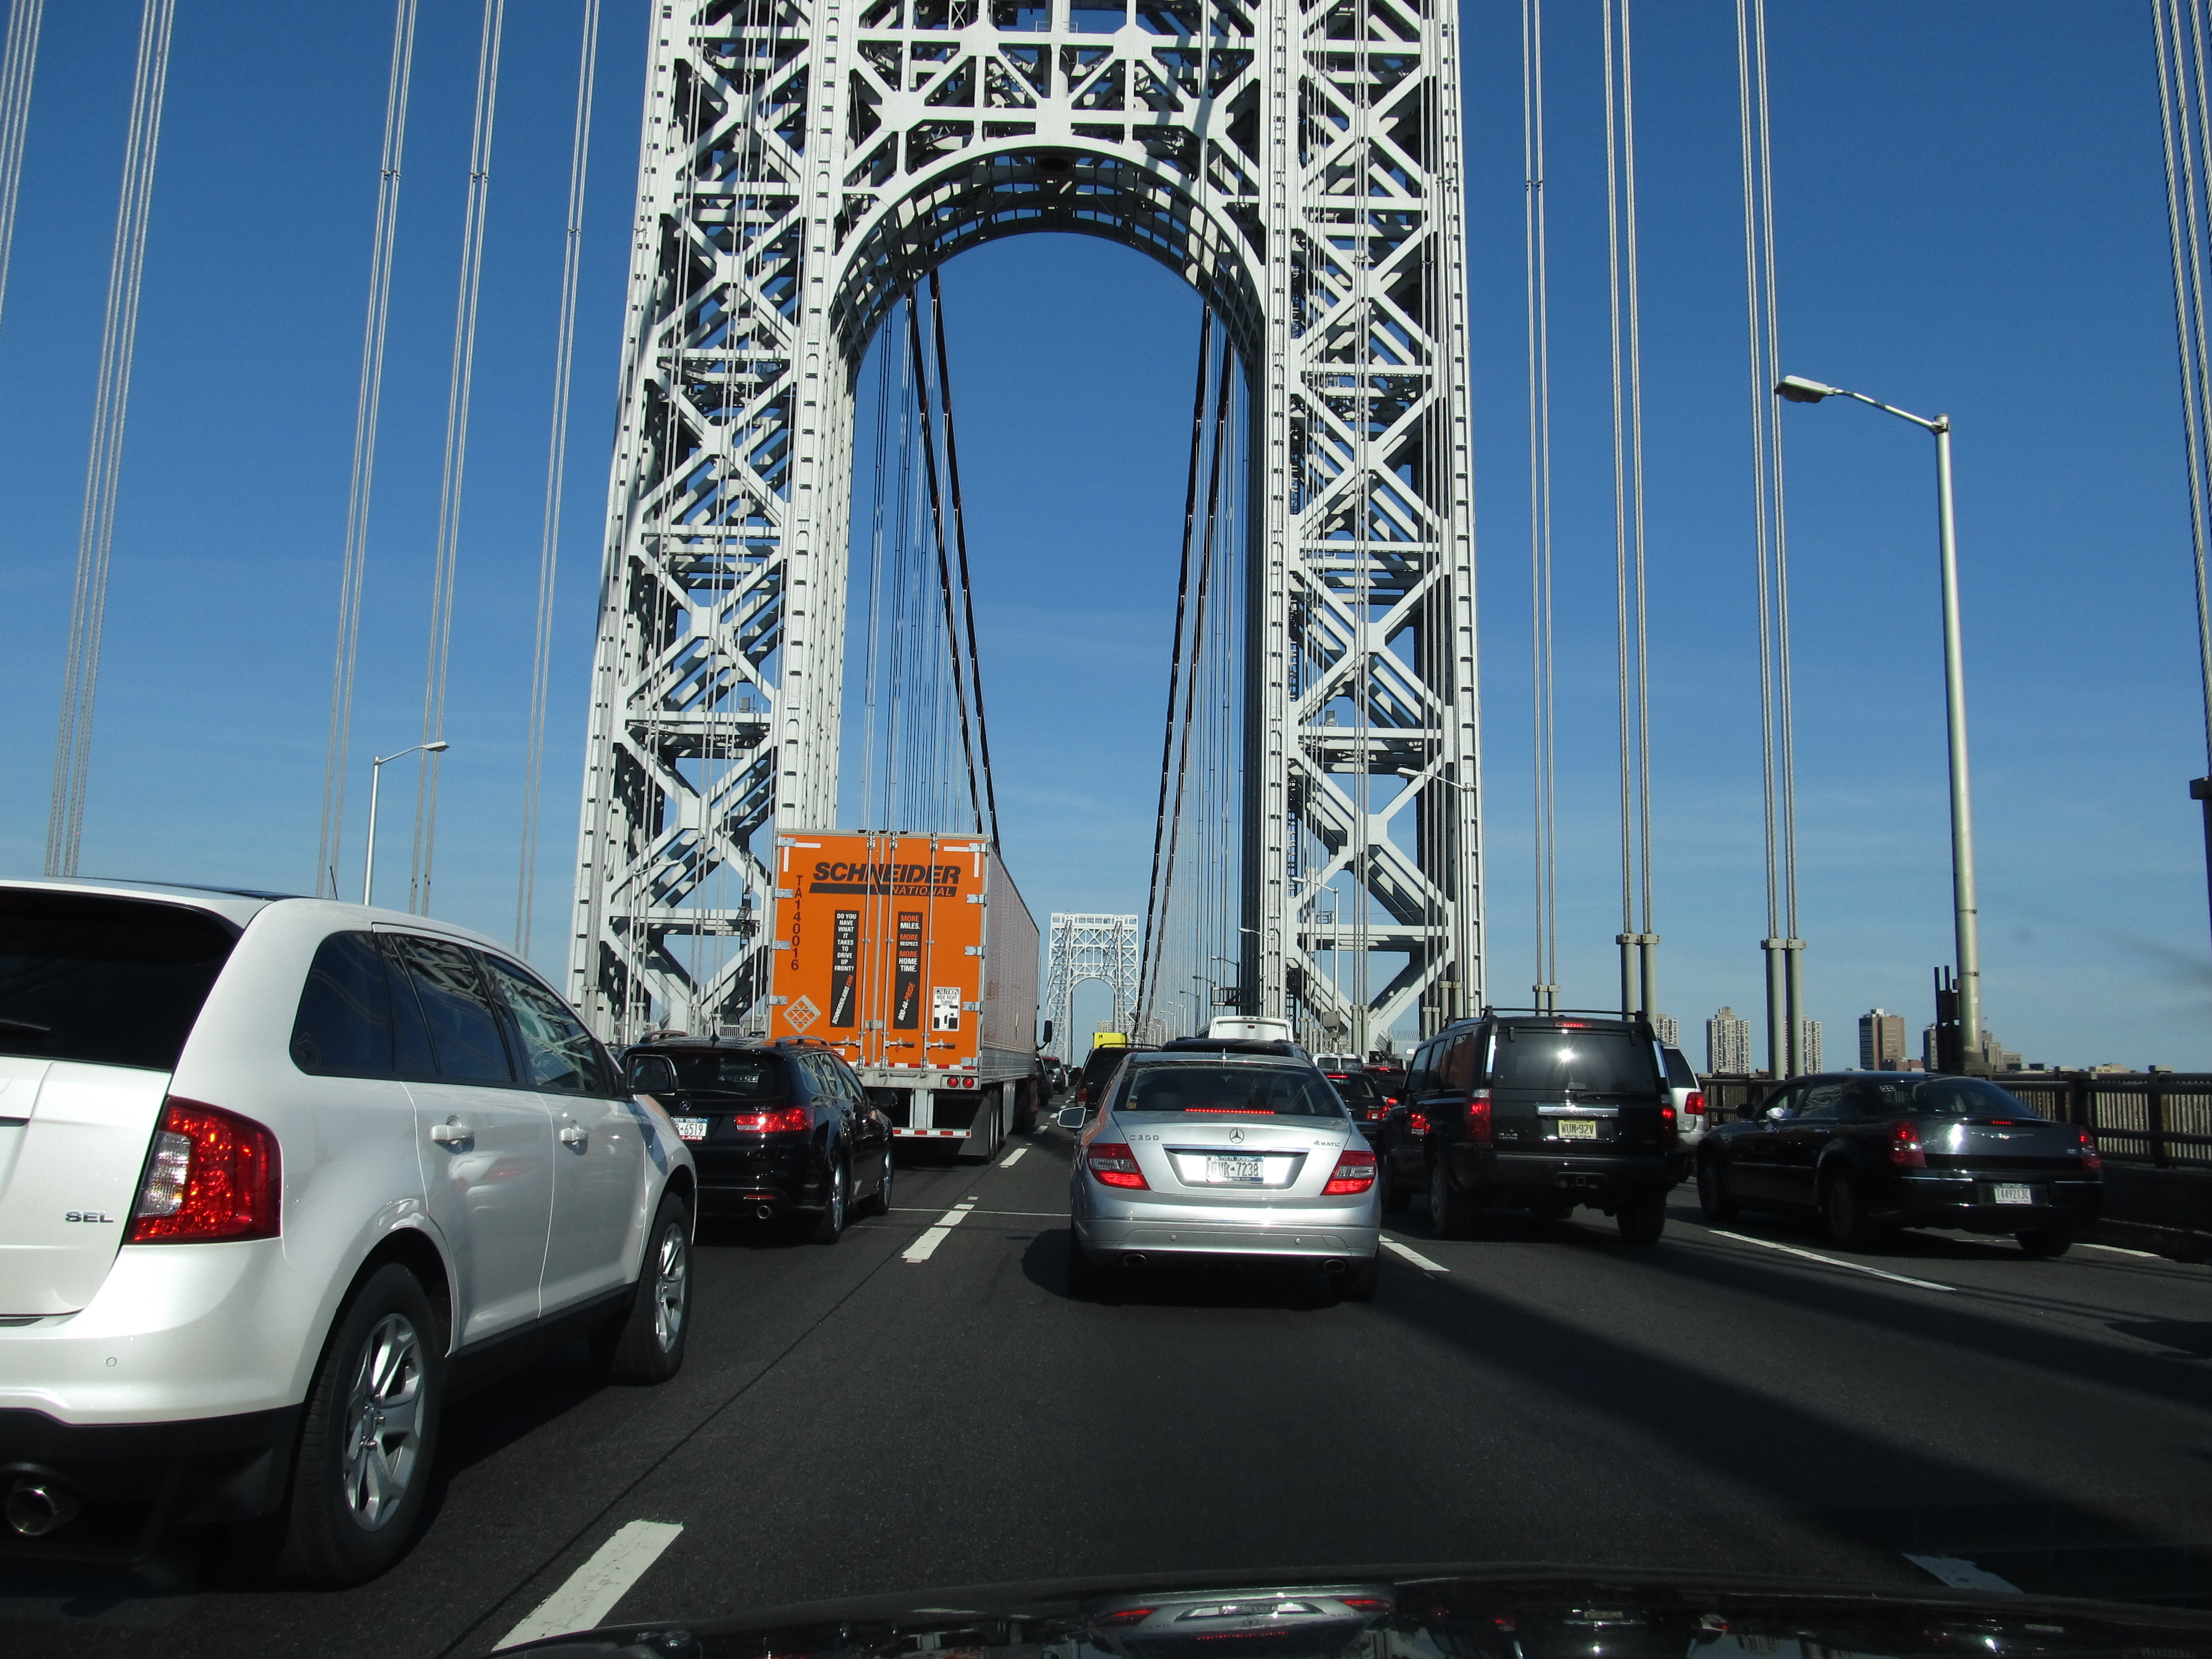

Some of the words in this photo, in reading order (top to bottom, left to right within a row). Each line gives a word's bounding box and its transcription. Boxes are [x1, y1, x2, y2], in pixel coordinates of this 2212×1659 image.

[813, 862, 961, 884] SCHNEIDER
[891, 885, 952, 896] NATIONAL
[791, 875, 803, 971] TA140016
[898, 982, 915, 1021] 800-44-PRIDE
[65, 1211, 114, 1222] SEL
